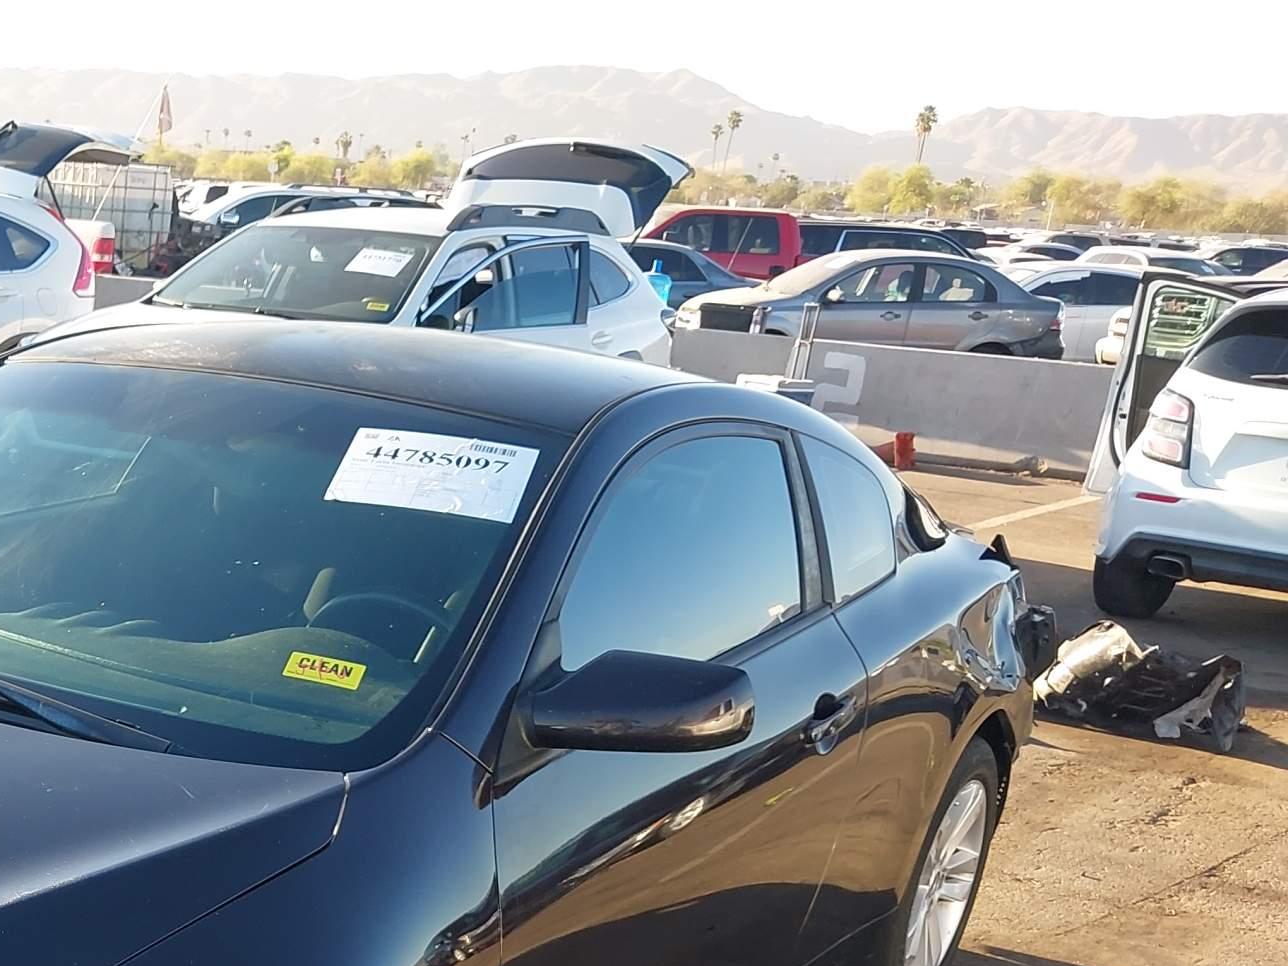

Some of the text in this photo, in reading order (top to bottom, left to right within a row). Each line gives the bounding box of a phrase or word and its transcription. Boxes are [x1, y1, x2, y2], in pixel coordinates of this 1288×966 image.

[810, 351, 867, 429] 2
[365, 445, 510, 474] 44785097
[298, 656, 354, 678] CLEAN
